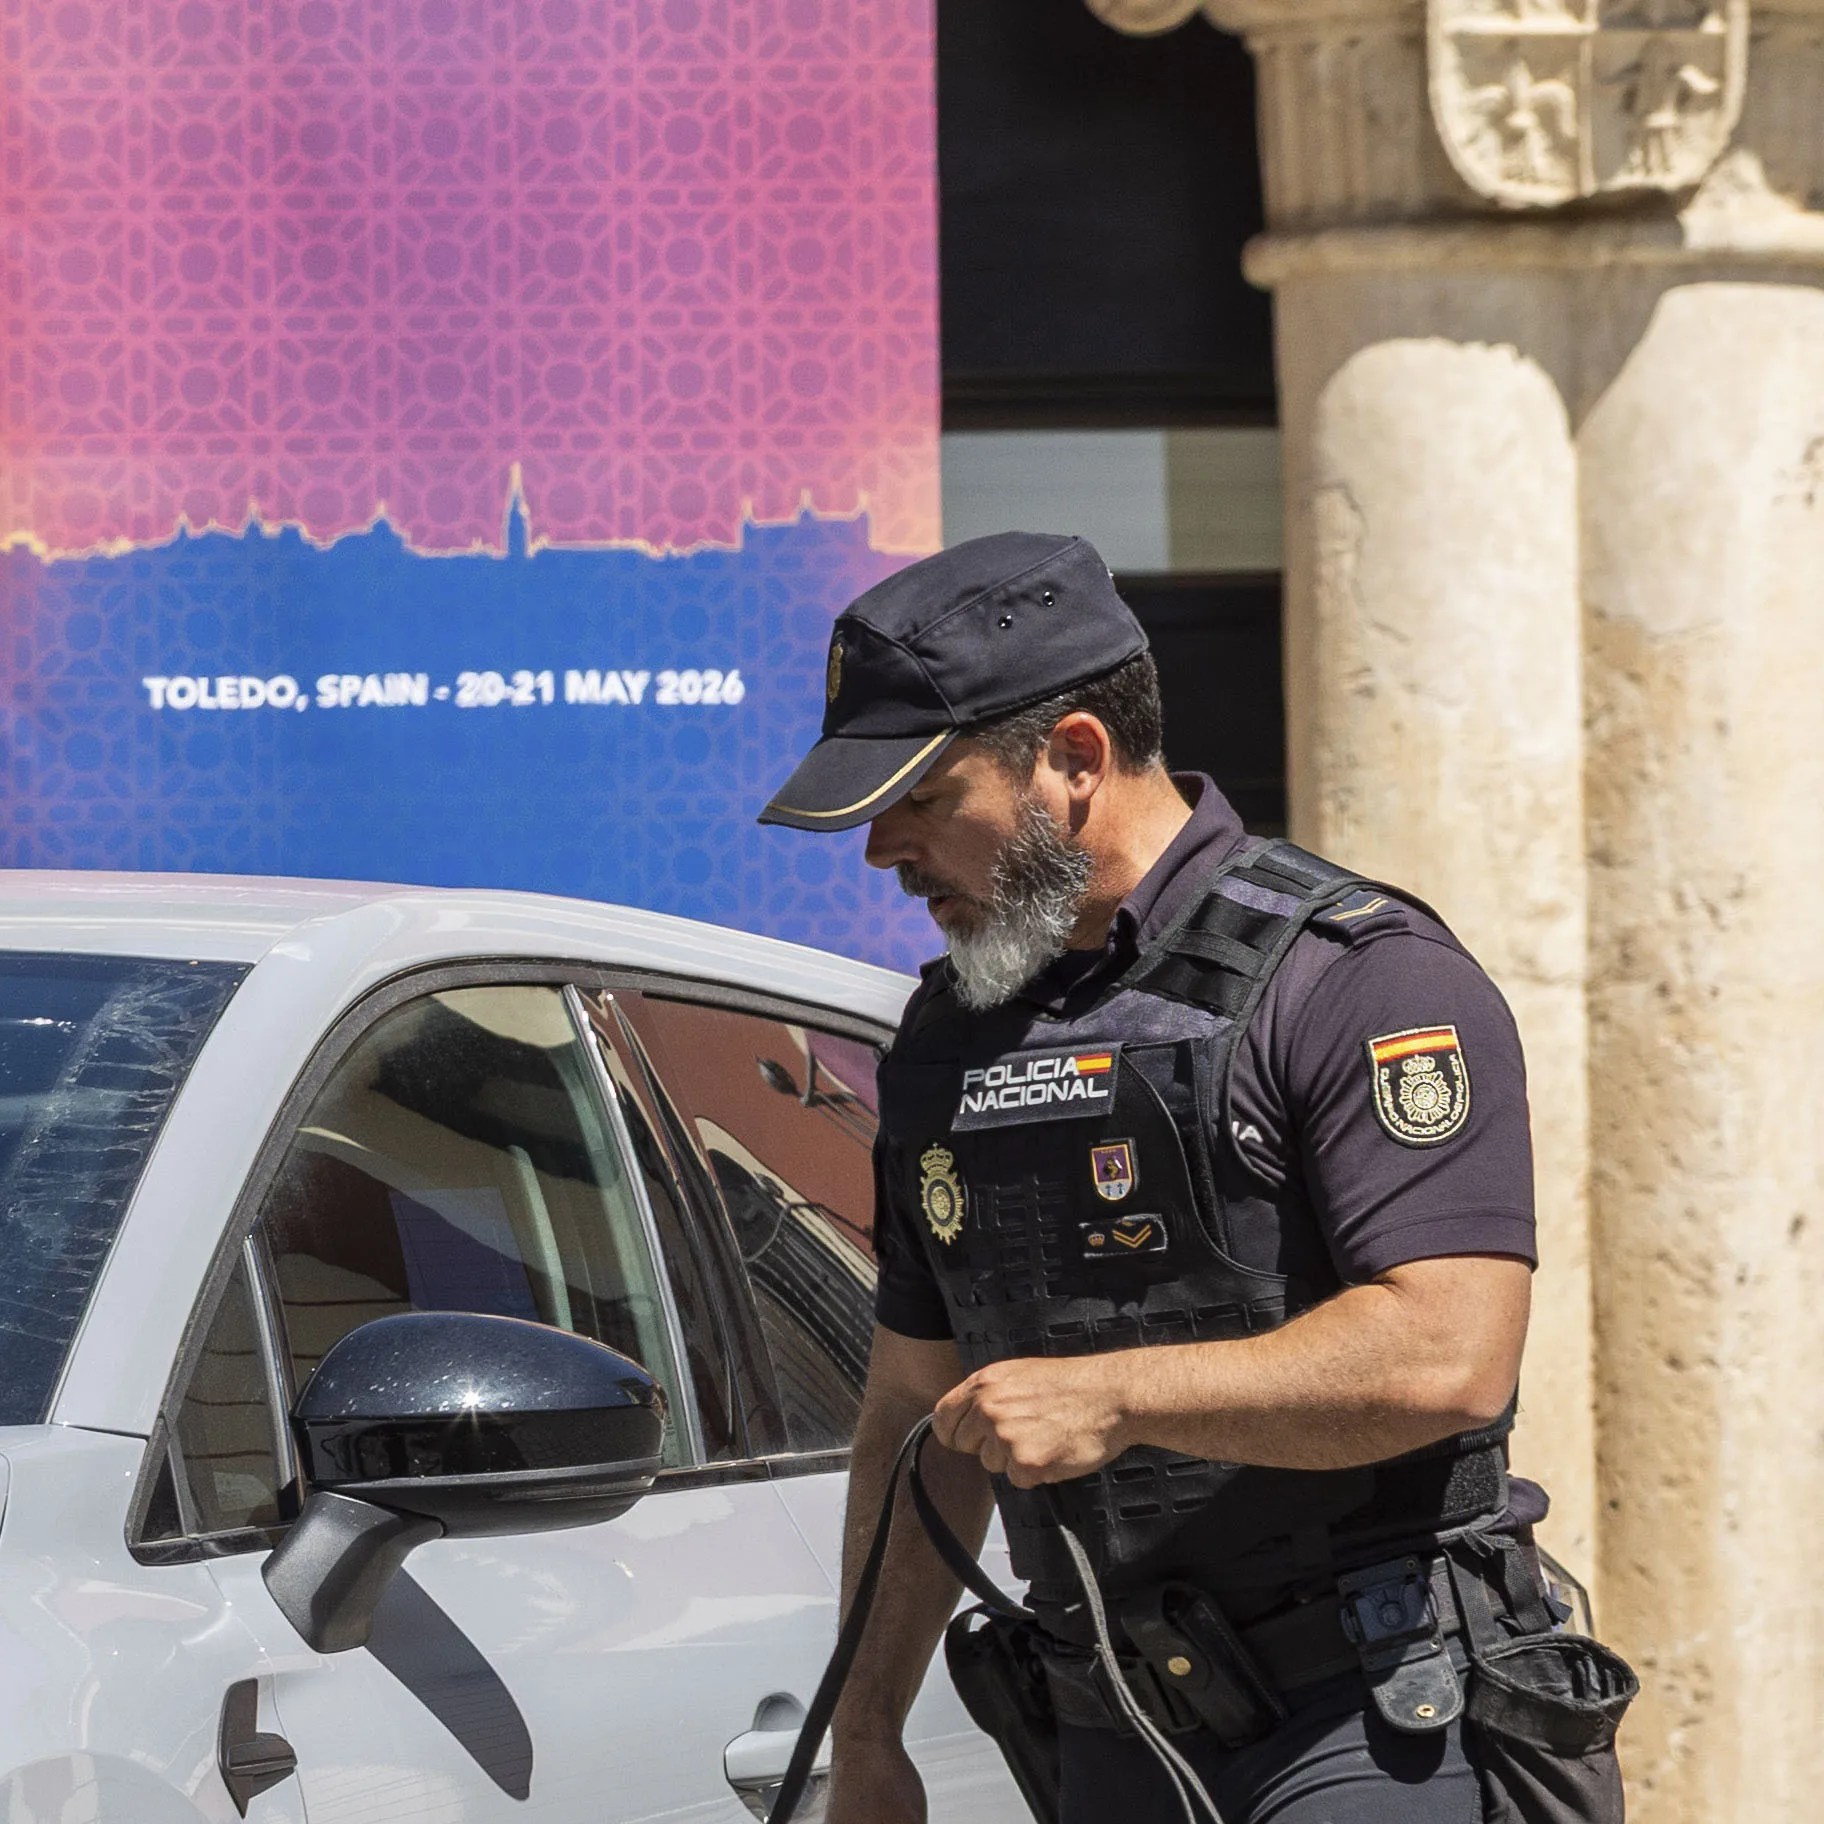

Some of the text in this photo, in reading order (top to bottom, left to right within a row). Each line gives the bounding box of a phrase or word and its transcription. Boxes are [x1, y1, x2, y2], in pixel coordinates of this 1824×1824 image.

[142, 675, 308, 712] TOLEDO,
[316, 672, 429, 708] SPAIN
[455, 669, 555, 708] 20-21
[564, 669, 652, 706] MAY
[655, 668, 746, 706] 2026
[963, 1056, 1079, 1090] POLICIA
[959, 1077, 1109, 1114] NACIONAL
